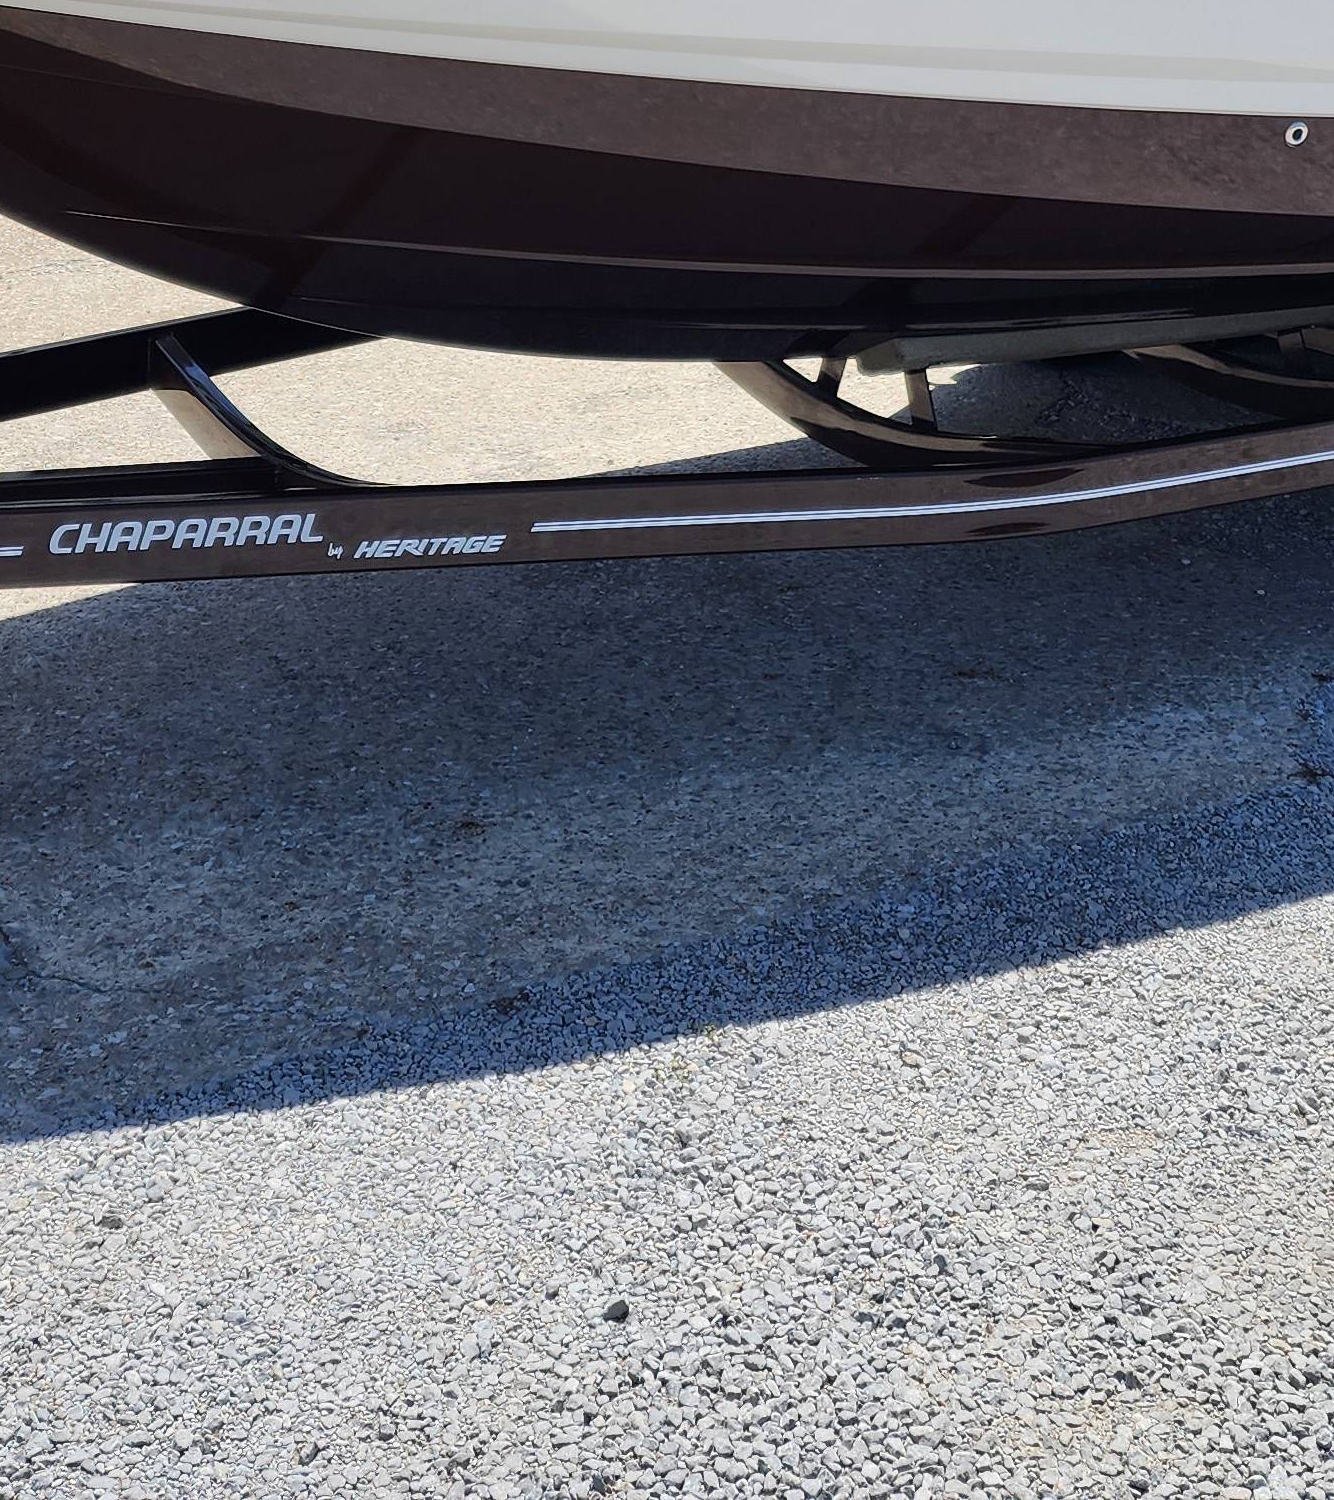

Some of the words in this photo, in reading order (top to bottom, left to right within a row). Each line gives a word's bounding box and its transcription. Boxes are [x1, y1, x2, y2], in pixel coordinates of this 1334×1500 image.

[48, 513, 325, 556] CHAPARRAL
[327, 541, 344, 560] by
[353, 533, 507, 560] HERITAGE
